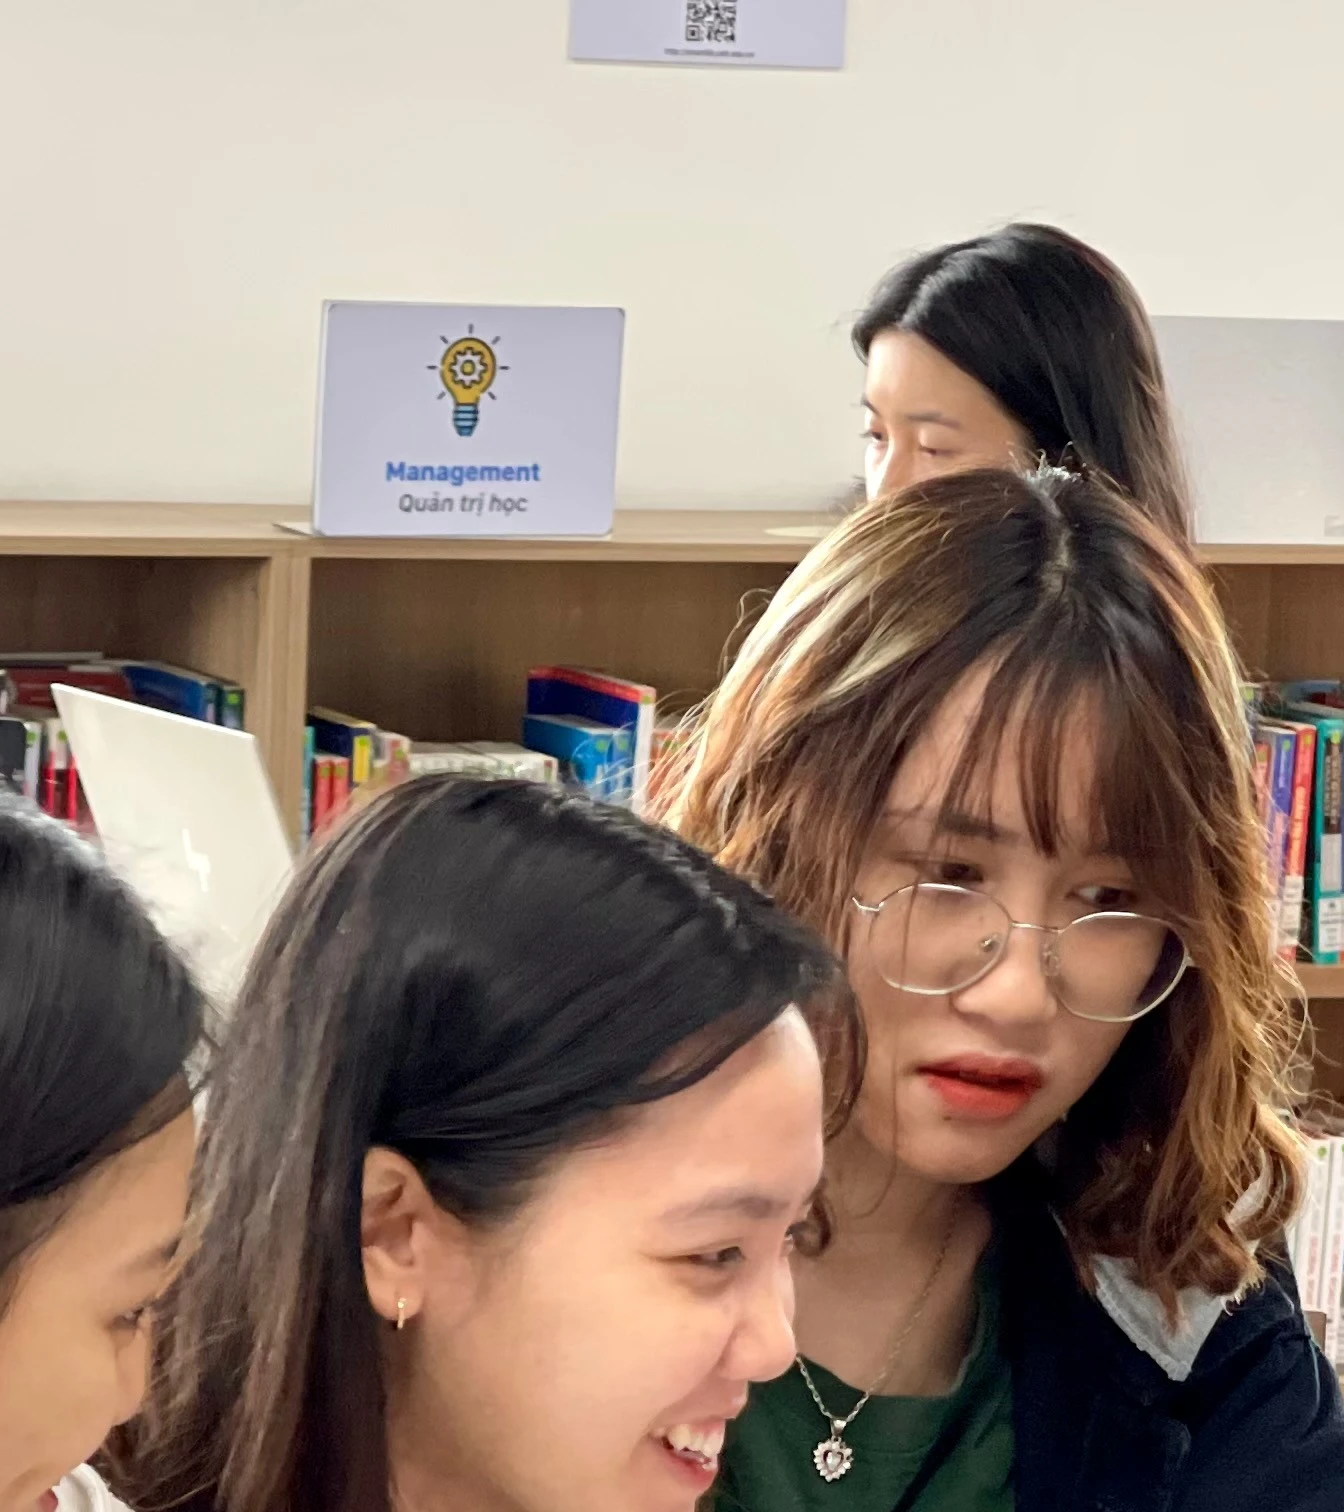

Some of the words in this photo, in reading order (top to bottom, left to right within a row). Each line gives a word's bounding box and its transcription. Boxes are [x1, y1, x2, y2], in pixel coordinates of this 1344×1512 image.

[386, 461, 541, 487] Management
[398, 491, 453, 513] Quản
[460, 493, 485, 517] trị
[488, 493, 528, 516] học
